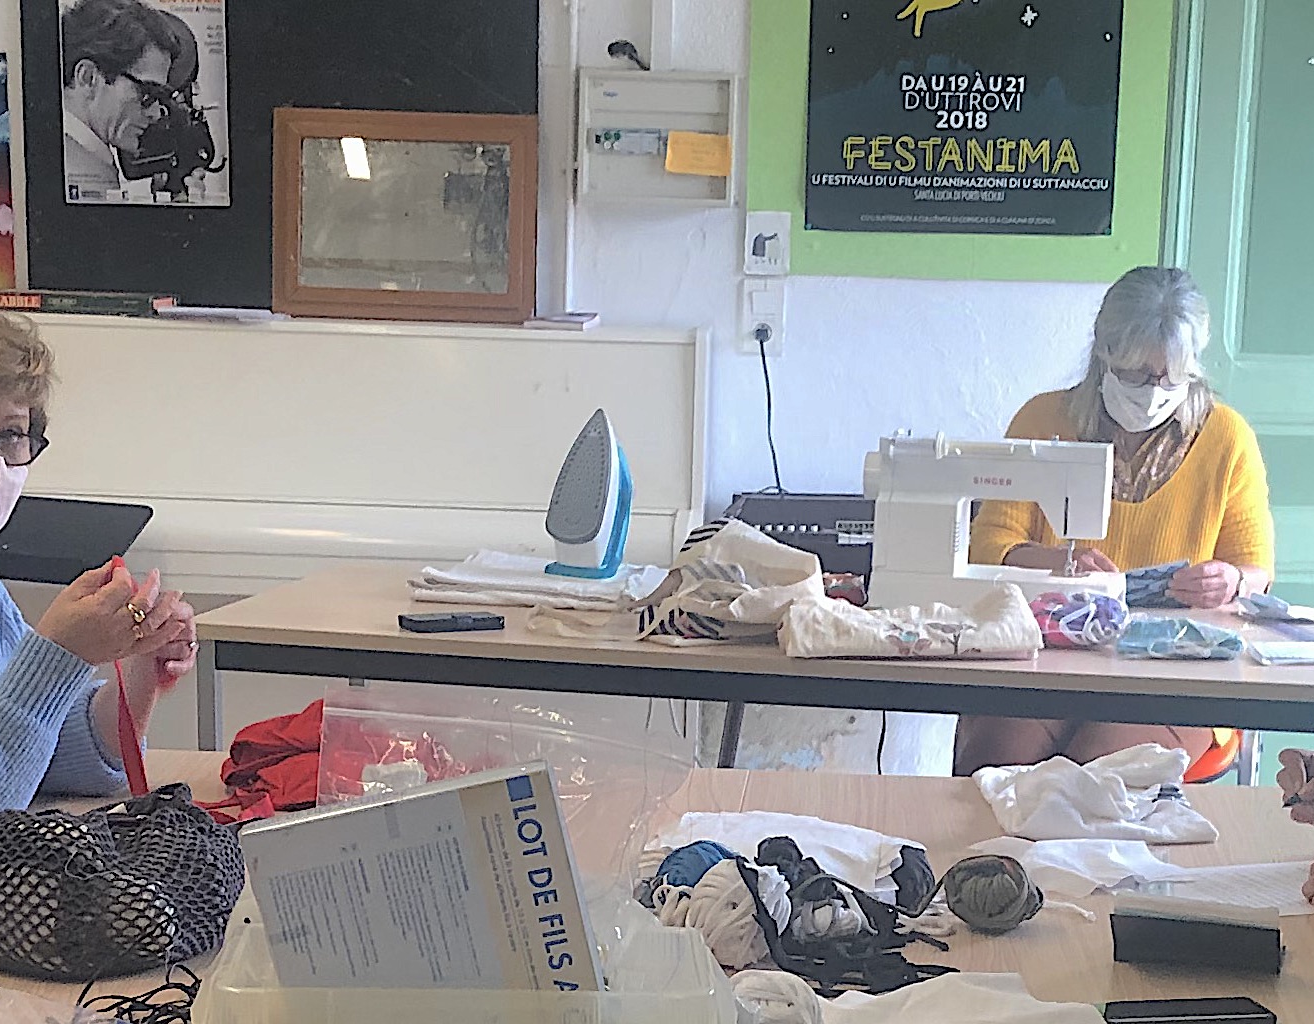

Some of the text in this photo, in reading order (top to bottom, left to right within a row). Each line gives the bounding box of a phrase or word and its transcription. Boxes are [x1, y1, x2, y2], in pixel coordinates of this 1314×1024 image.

[901, 71, 1026, 93] DA U 19 À U 21
[904, 92, 1021, 112] D'UTTROVI
[936, 111, 988, 129] 2018
[842, 135, 1080, 174] FESTANIMA
[811, 174, 821, 185] U
[875, 176, 886, 186] DI
[888, 176, 897, 186] U
[898, 176, 931, 188] FILMU
[1009, 178, 1020, 189] DI
[1023, 178, 1031, 189] U
[1033, 178, 1110, 190] SUTTANACCIU
[972, 476, 1012, 486] SINGER
[511, 804, 548, 857] LOT
[526, 866, 559, 907] DE
[538, 913, 573, 970] FILS
